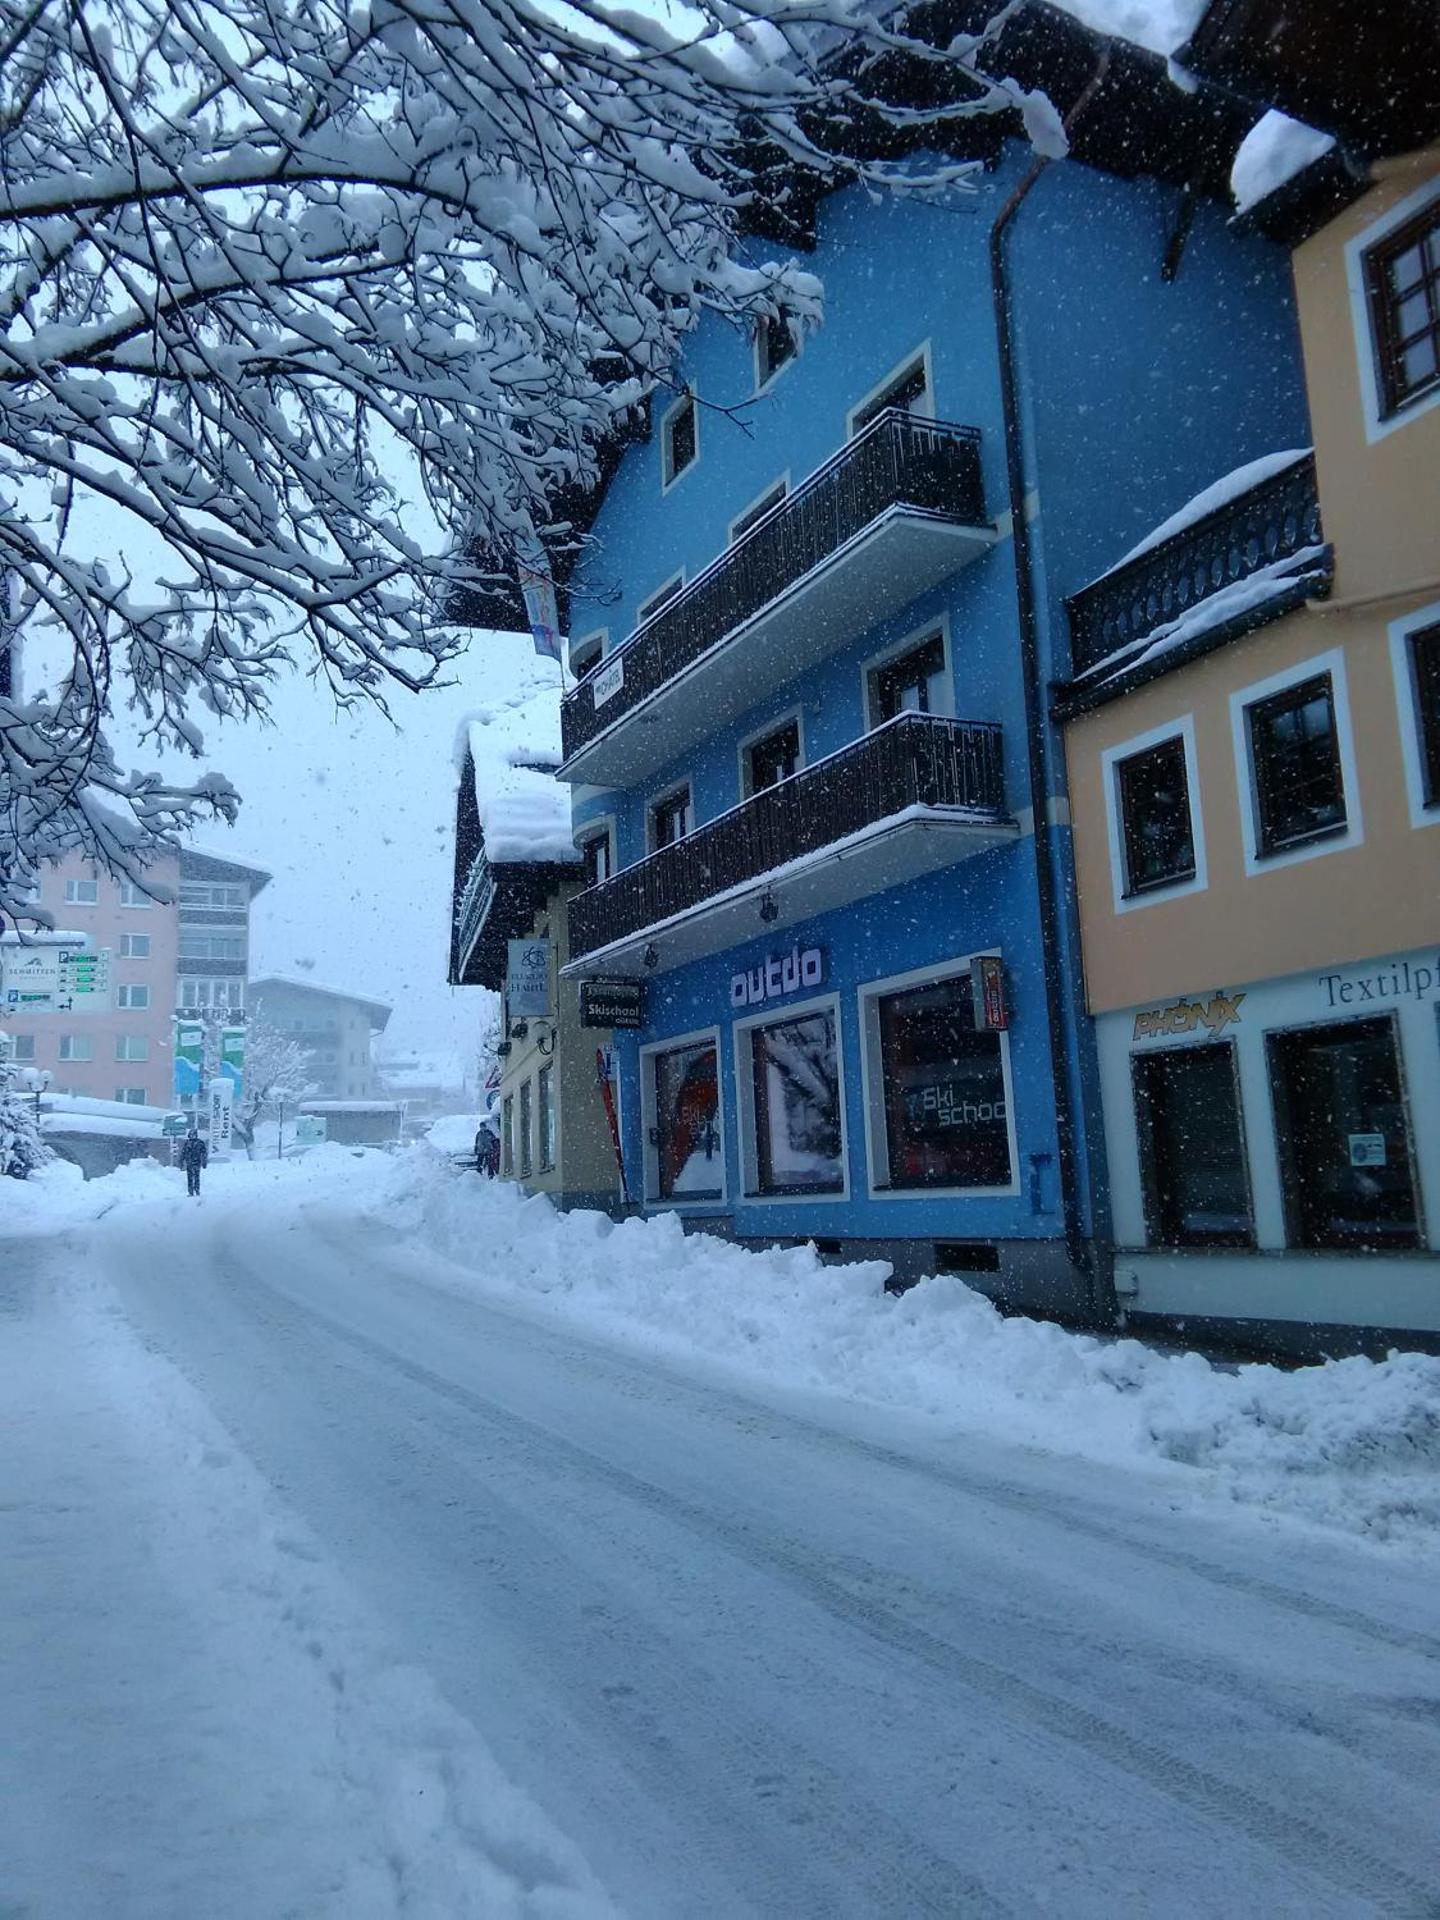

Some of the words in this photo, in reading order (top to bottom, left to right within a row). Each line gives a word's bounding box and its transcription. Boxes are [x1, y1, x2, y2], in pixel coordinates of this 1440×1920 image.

[730, 945, 822, 1008] outdo
[923, 1083, 953, 1110] Ski
[221, 1106, 230, 1139] Rent
[938, 1101, 1006, 1127] schoo
